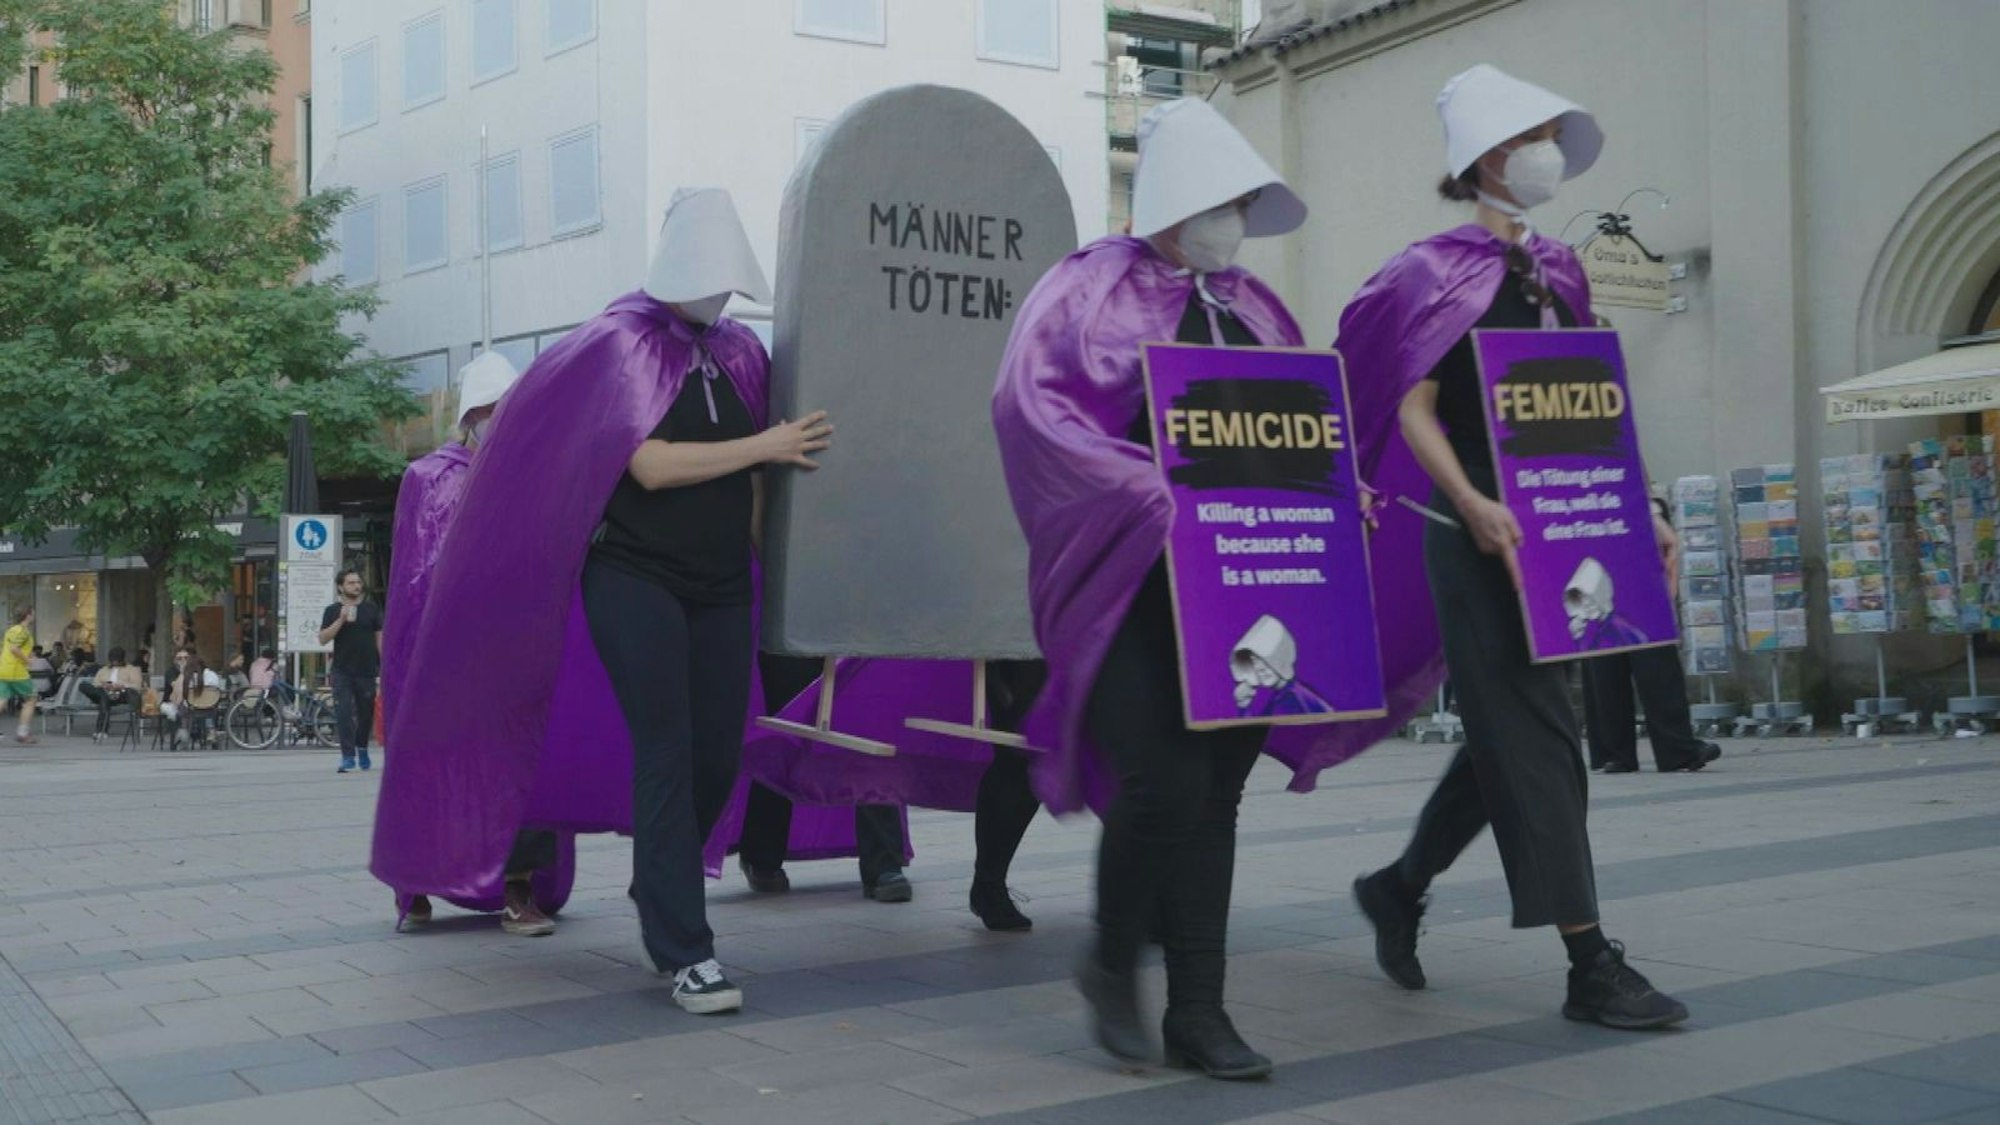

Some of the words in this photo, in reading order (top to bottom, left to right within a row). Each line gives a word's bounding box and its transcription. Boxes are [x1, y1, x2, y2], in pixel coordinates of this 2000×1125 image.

[869, 202, 1024, 261] MÄNNER
[881, 264, 1013, 321] TÖTEN:
[1493, 381, 1626, 422] FEMIZID
[1164, 408, 1345, 450] FEMICIDE
[1197, 502, 1257, 528] Killing
[1257, 507, 1271, 522] a
[1271, 507, 1335, 522] woman
[1215, 533, 1292, 554] because
[1293, 533, 1326, 553] she
[1221, 566, 1239, 585] is
[1241, 570, 1255, 585] a
[1255, 568, 1327, 584] woman.
